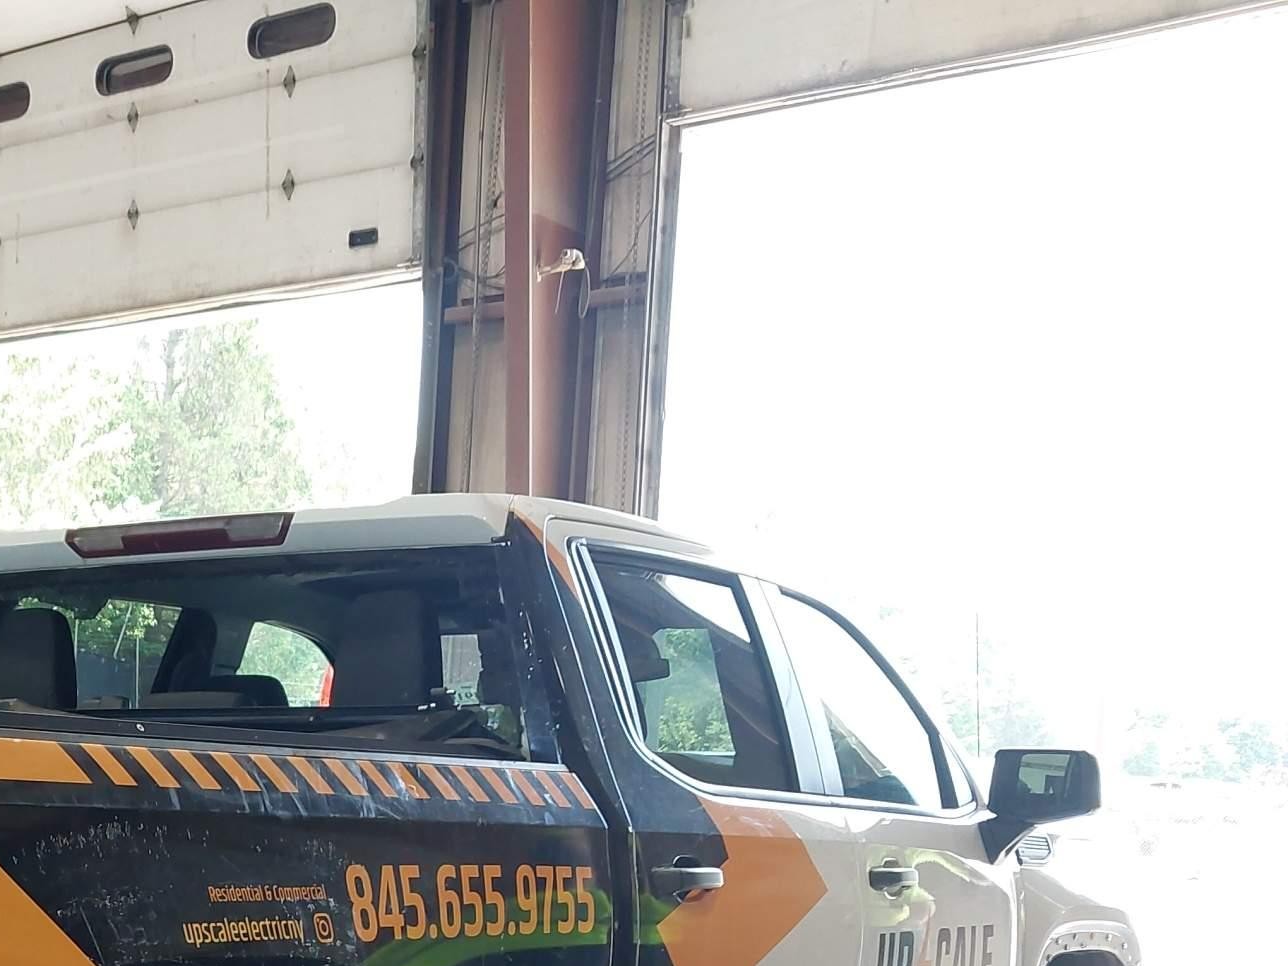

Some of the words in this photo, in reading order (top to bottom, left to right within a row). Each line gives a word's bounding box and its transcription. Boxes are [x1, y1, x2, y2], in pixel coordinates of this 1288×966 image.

[208, 884, 264, 903] Residential
[265, 885, 273, 901] &
[273, 883, 328, 903] Commercial
[345, 864, 596, 943] 845.655.9755
[183, 915, 305, 948] upscaleelectricny
